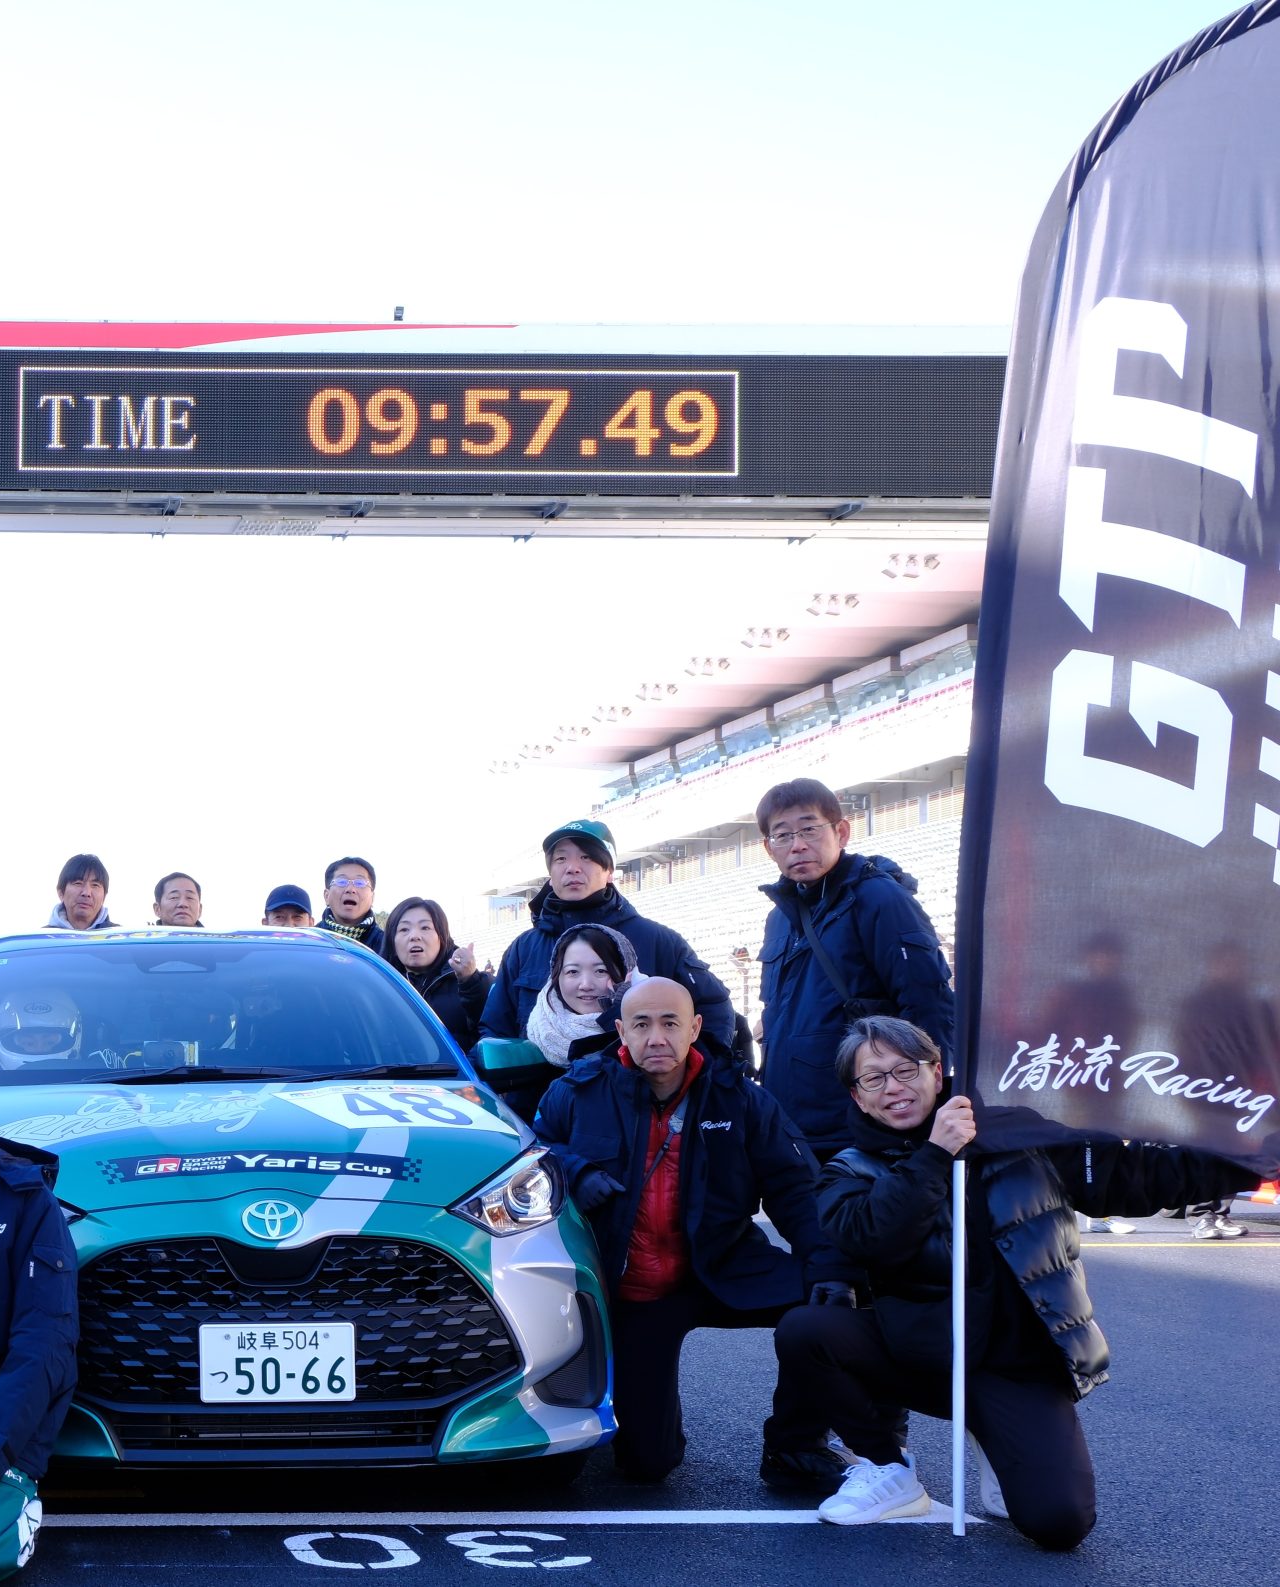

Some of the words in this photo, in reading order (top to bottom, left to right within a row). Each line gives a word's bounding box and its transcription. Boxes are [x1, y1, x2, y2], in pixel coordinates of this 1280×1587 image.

[37, 395, 197, 450] TIME
[307, 388, 718, 456] 09:57.49
[998, 1033, 1120, 1093] 清流
[1120, 1051, 1276, 1133] Racing
[342, 1092, 473, 1126] 48
[701, 1120, 732, 1131] Racing
[138, 1162, 178, 1174] GR
[233, 1153, 342, 1171] Yaris
[345, 1162, 392, 1176] Cup
[181, 1164, 226, 1173] Racing
[182, 1155, 232, 1163] TOYOTA
[237, 1331, 279, 1350] 岐阜
[282, 1330, 320, 1350] 504
[209, 1371, 229, 1384] つ
[235, 1356, 346, 1395] 50-66
